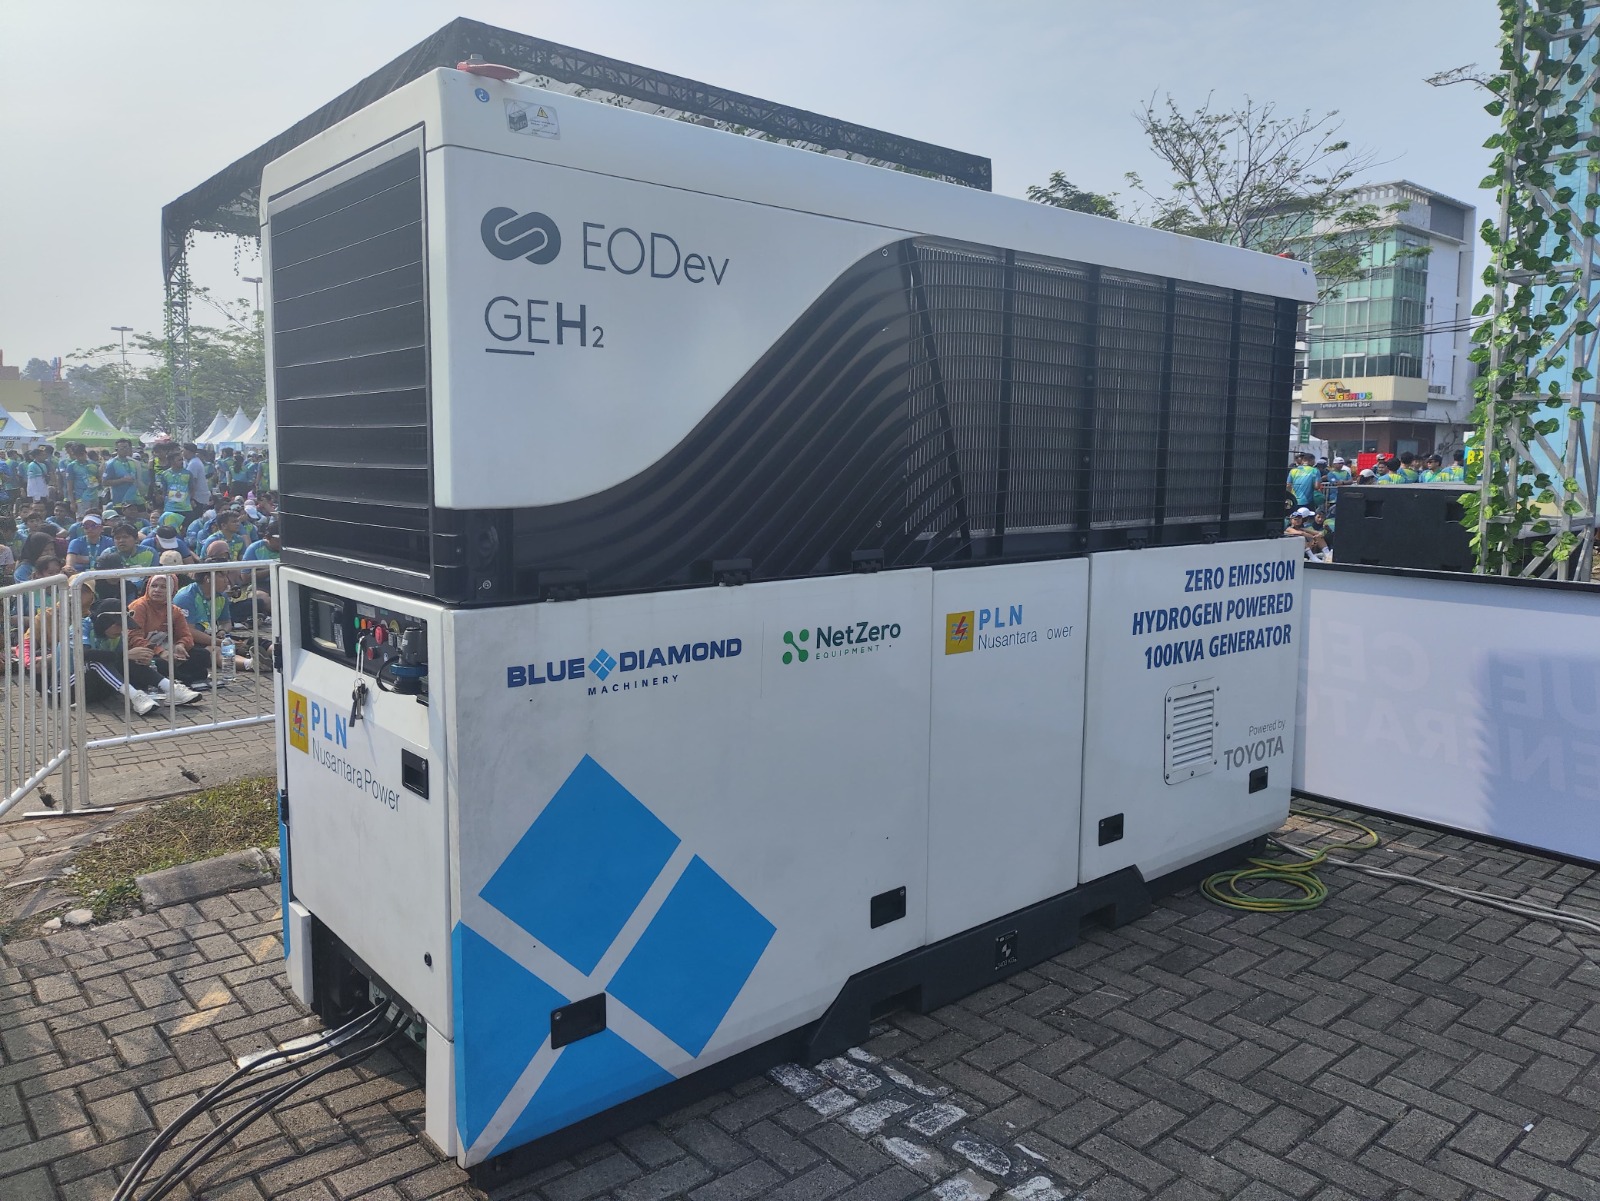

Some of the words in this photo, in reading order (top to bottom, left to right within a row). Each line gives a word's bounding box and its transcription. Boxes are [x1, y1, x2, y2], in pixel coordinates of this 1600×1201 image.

[582, 221, 730, 286] EODev
[1336, 391, 1373, 400] GENIUS
[1185, 566, 1224, 592] ZERO
[1228, 559, 1295, 588] EMISSION
[978, 604, 1023, 630] PLN
[1132, 601, 1223, 635] HYDROGEN
[1226, 592, 1293, 621] POWERED
[816, 621, 901, 650] NetZero
[978, 627, 1038, 650] Nusantara
[1144, 638, 1205, 669] 100KVA
[1208, 623, 1292, 656] GENERATOR
[507, 657, 585, 688] BLUE
[619, 638, 742, 672] DIAMOND
[815, 644, 880, 660] EQUIPMENT
[588, 674, 679, 696] MACHINERY
[311, 701, 347, 749] PLN
[1248, 720, 1276, 737] Powered
[1277, 718, 1286, 732] by
[1223, 736, 1284, 771] TOYOTA
